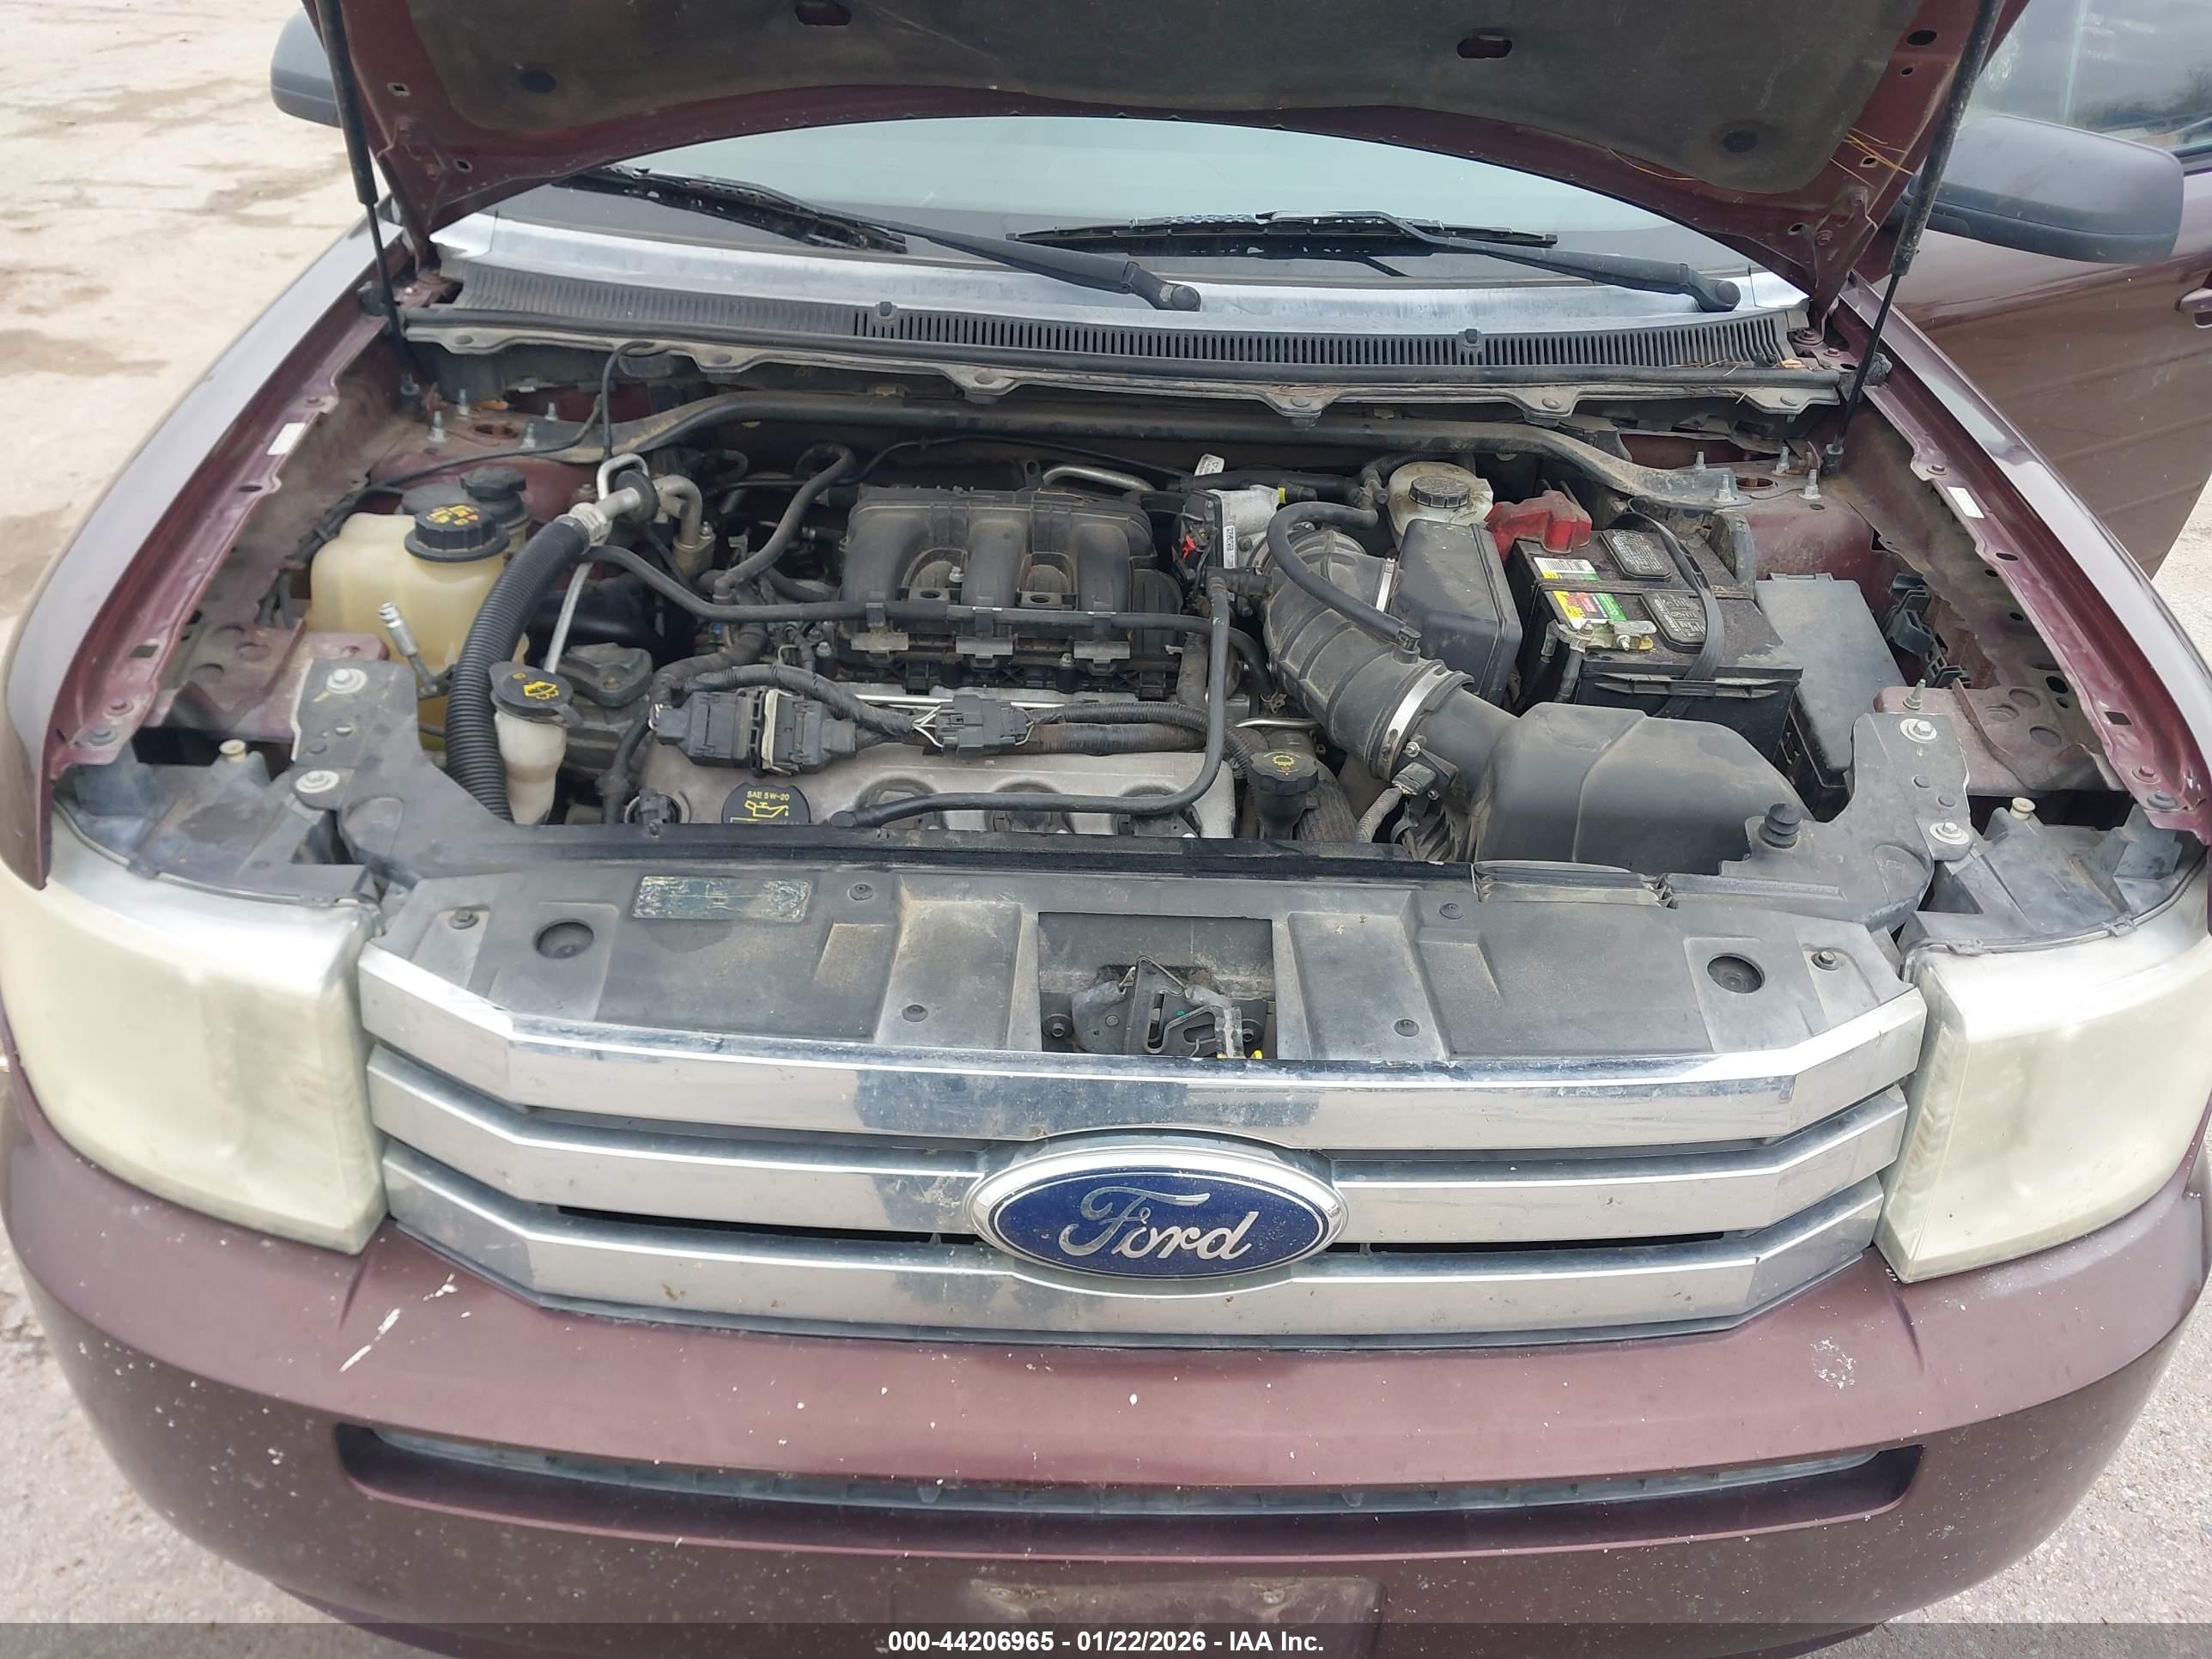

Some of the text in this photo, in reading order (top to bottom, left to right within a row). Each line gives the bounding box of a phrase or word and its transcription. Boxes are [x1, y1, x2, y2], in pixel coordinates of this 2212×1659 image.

[746, 790, 790, 801] SAE 5W-20
[1058, 1185, 1261, 1261] Ford
